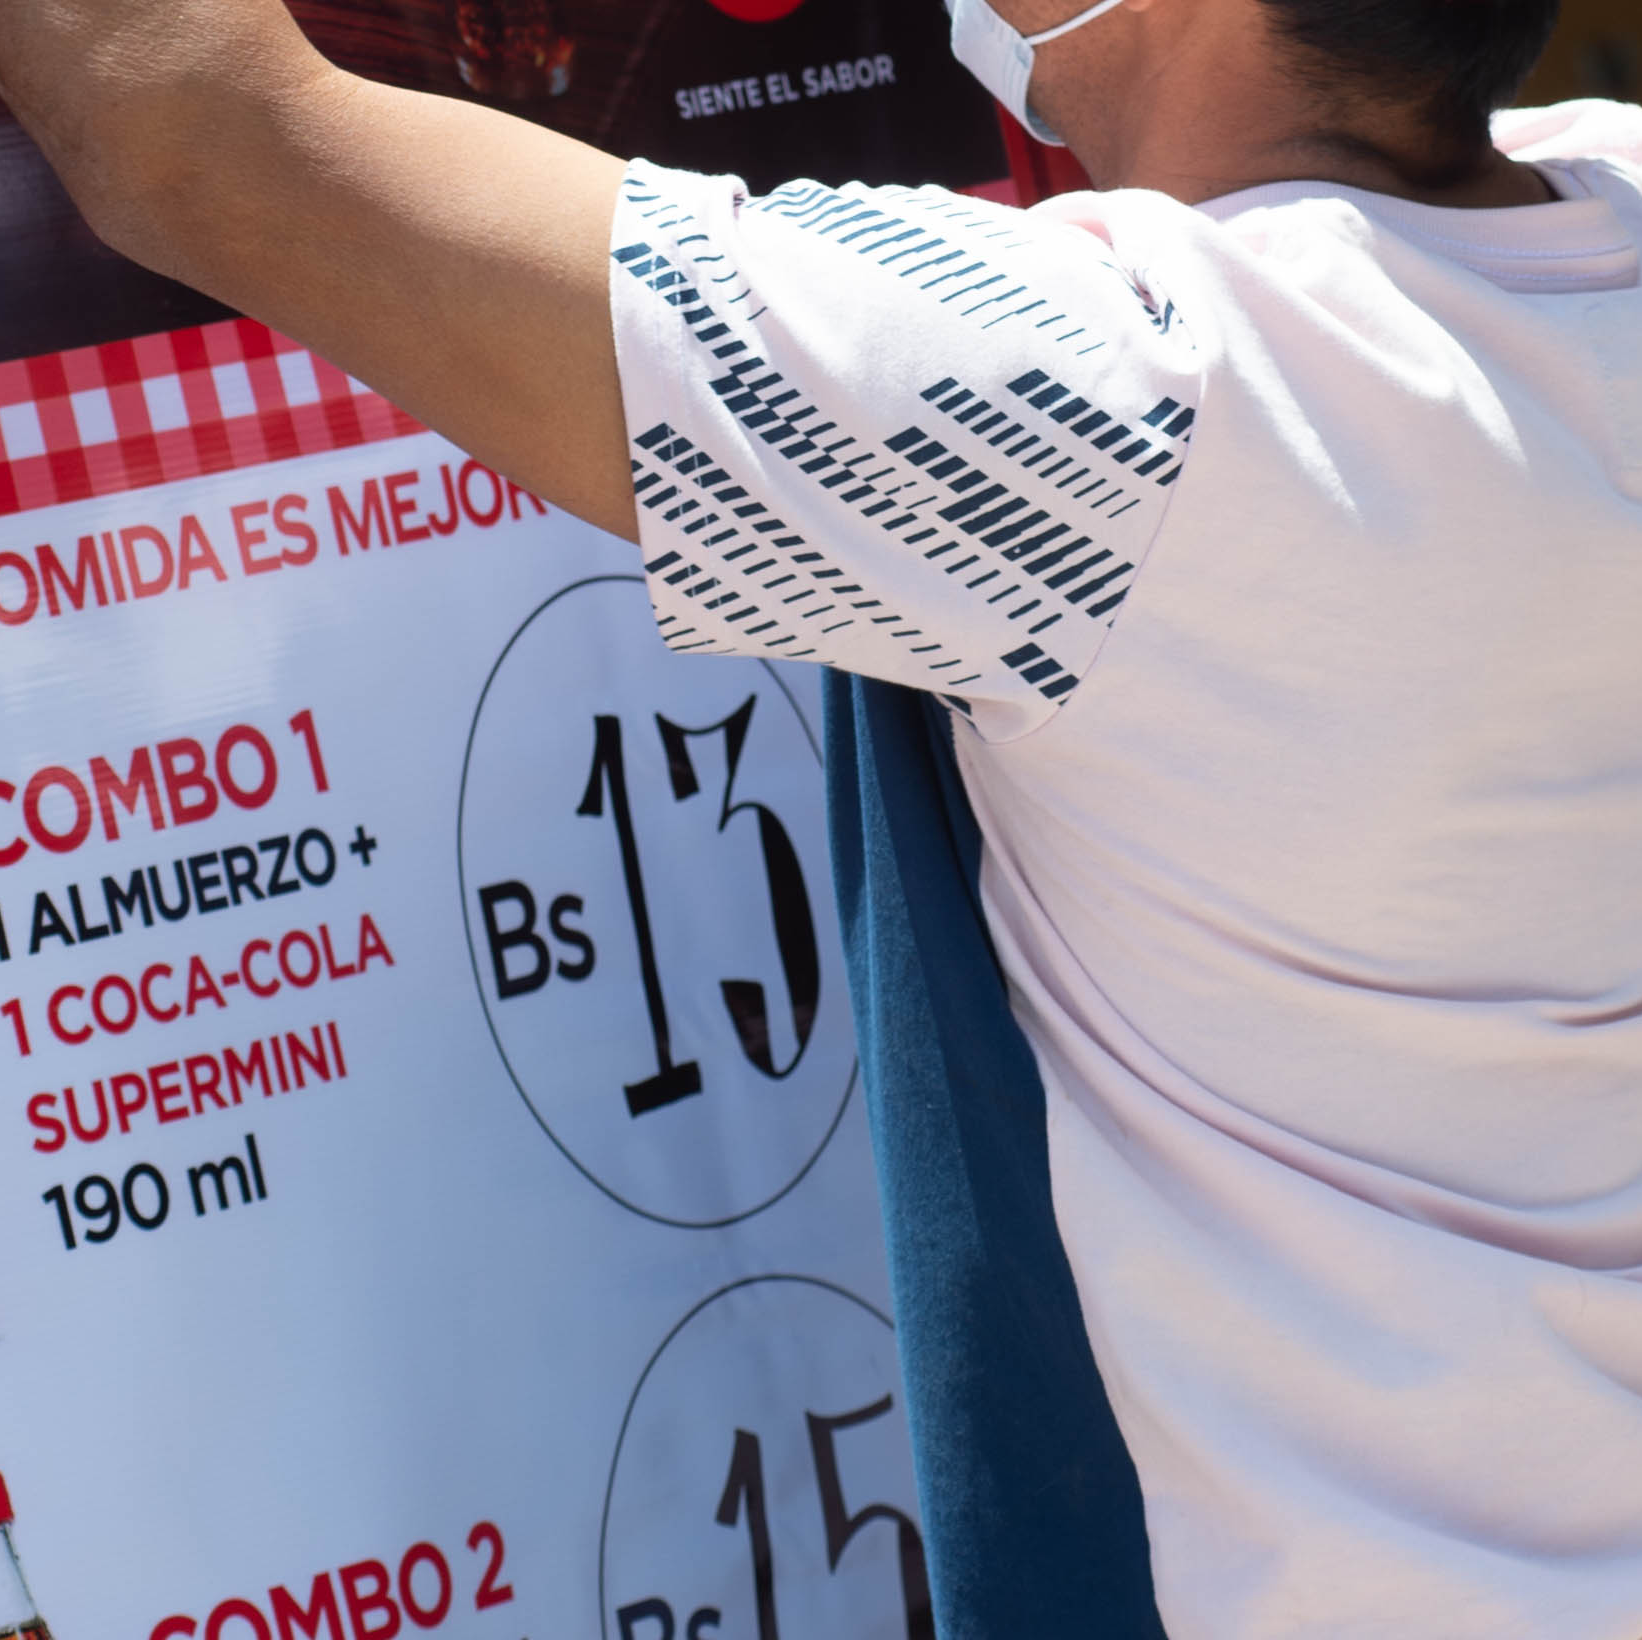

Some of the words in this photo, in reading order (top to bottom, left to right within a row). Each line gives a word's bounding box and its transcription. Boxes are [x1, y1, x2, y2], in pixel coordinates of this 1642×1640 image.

[675, 77, 764, 120] SIENTE
[765, 72, 800, 104] EL
[802, 54, 897, 98] SABOR
[230, 495, 318, 574] ES
[289, 708, 329, 793] 1
[28, 827, 337, 955] ALMUERZO
[349, 824, 378, 867] +
[478, 879, 597, 1001] Bs
[576, 693, 820, 1119] 13
[0, 997, 31, 1057] 1
[47, 913, 395, 1045] COCA-COLA
[26, 1021, 349, 1153] SUPERMINI
[41, 1162, 171, 1251] 190
[187, 1132, 268, 1217] ml
[714, 1392, 936, 1640] 15
[149, 1541, 453, 1640] OMBO
[466, 1520, 514, 1612] 2
